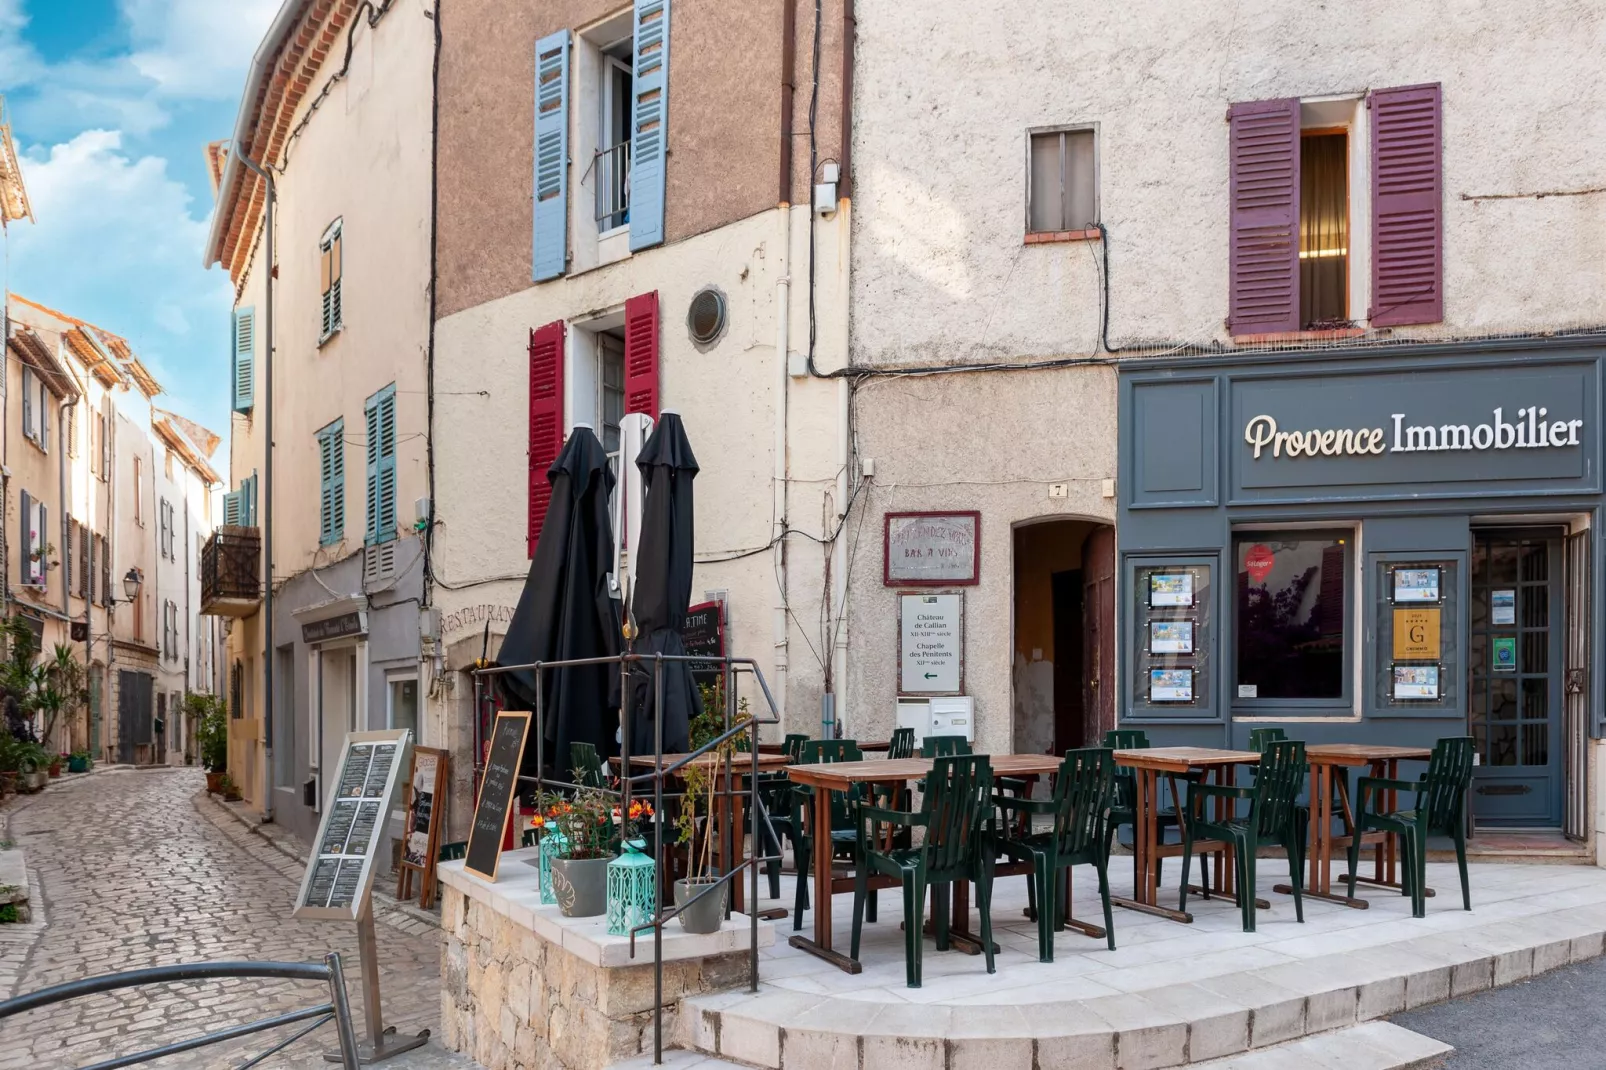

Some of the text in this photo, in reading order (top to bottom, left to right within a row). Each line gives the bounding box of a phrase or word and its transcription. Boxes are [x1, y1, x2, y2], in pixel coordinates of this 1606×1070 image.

[1245, 406, 1583, 459] Provence Immobilier
[1055, 485, 1061, 496] 7
[440, 604, 516, 634] RESTAURAN
[1410, 625, 1424, 643] G
